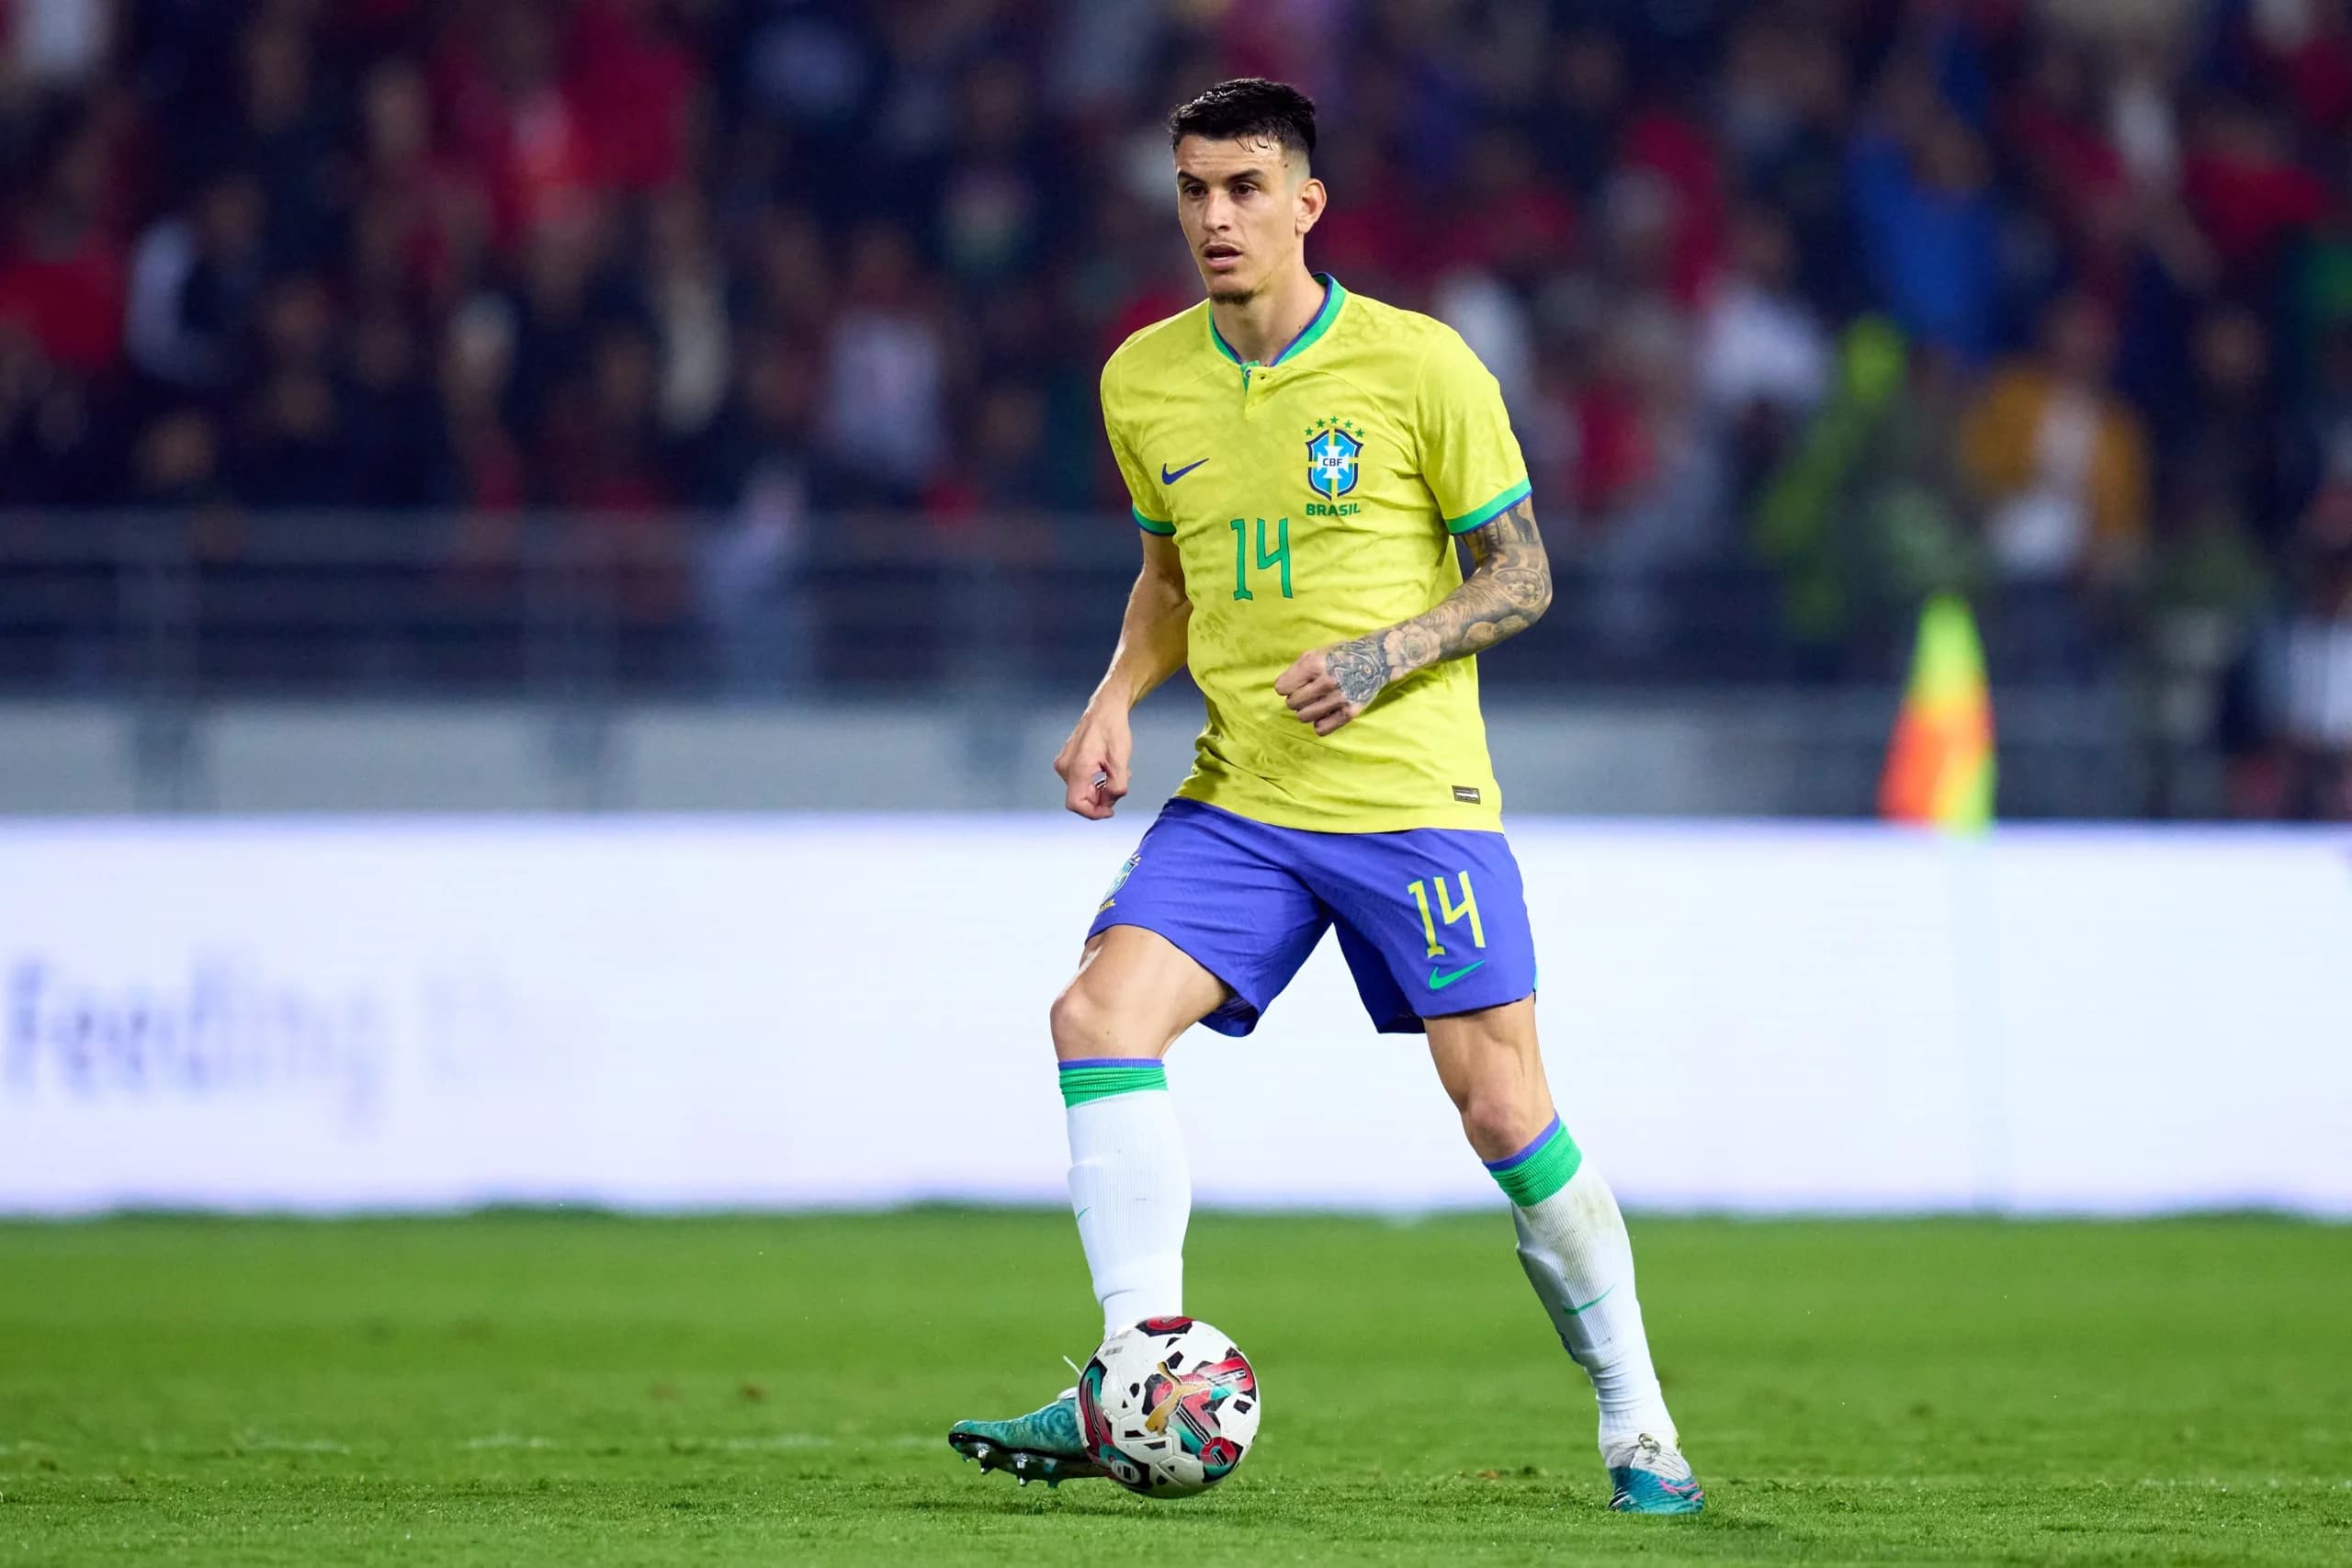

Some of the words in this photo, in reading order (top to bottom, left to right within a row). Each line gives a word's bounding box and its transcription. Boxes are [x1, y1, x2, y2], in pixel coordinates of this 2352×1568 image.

[1322, 457, 1343, 467] CBF
[1306, 502, 1362, 516] BRASIL
[1230, 517, 1293, 601] 14
[1408, 870, 1486, 959] 14
